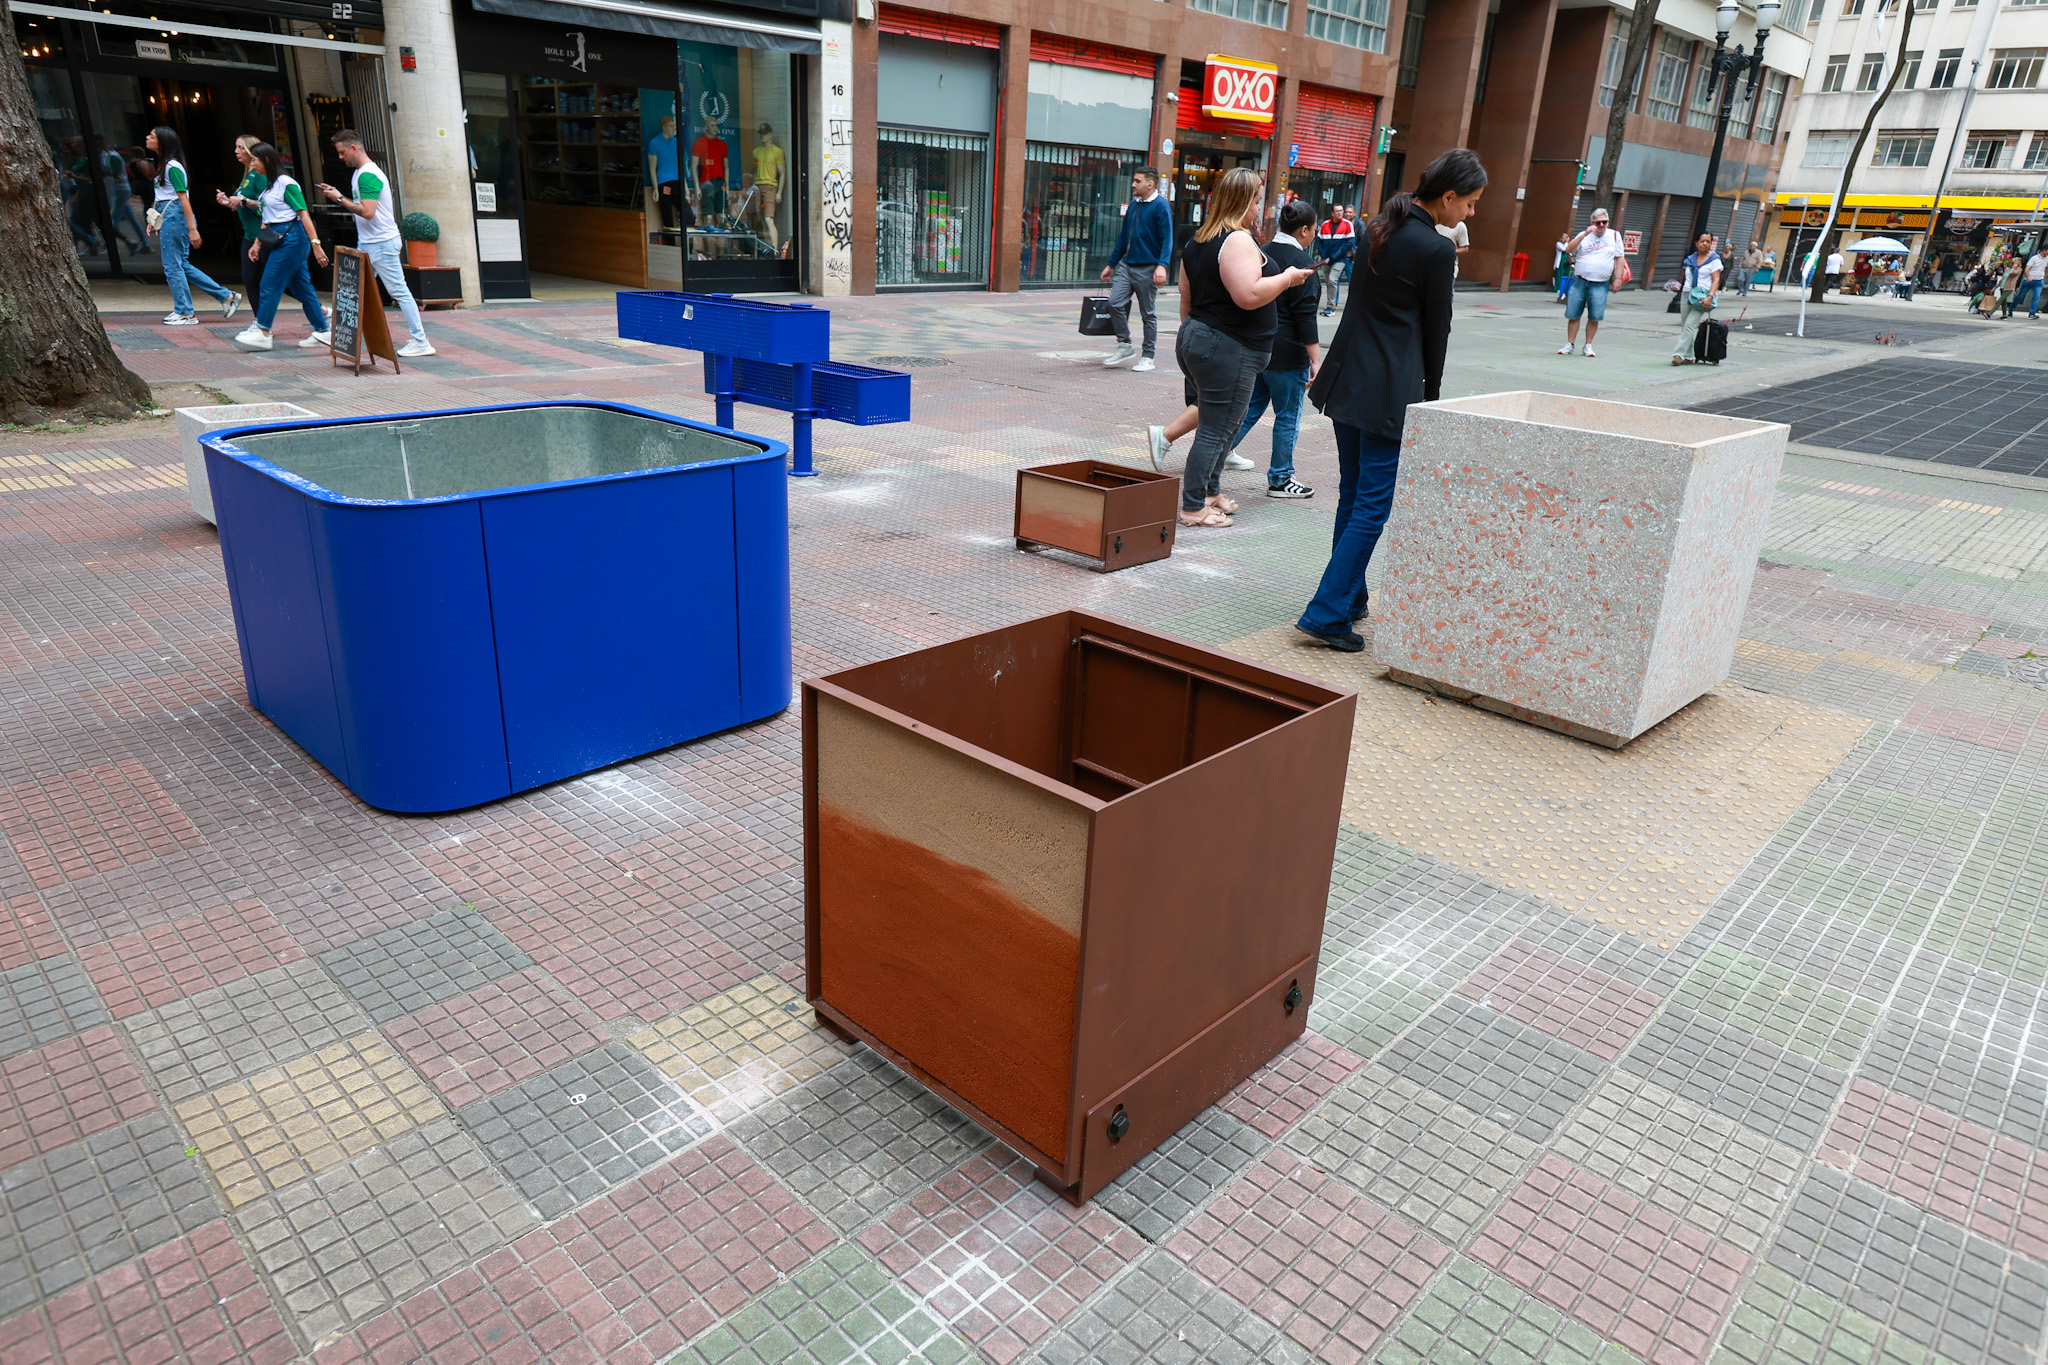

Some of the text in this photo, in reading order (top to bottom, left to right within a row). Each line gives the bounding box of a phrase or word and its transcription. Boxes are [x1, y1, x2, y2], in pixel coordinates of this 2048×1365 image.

[333, 3, 353, 20] 22
[152, 47, 167, 55] VINDO
[544, 47, 565, 57] HOLE
[588, 53, 603, 61] ONE
[831, 85, 844, 96] 16
[1214, 69, 1275, 110] OXXO
